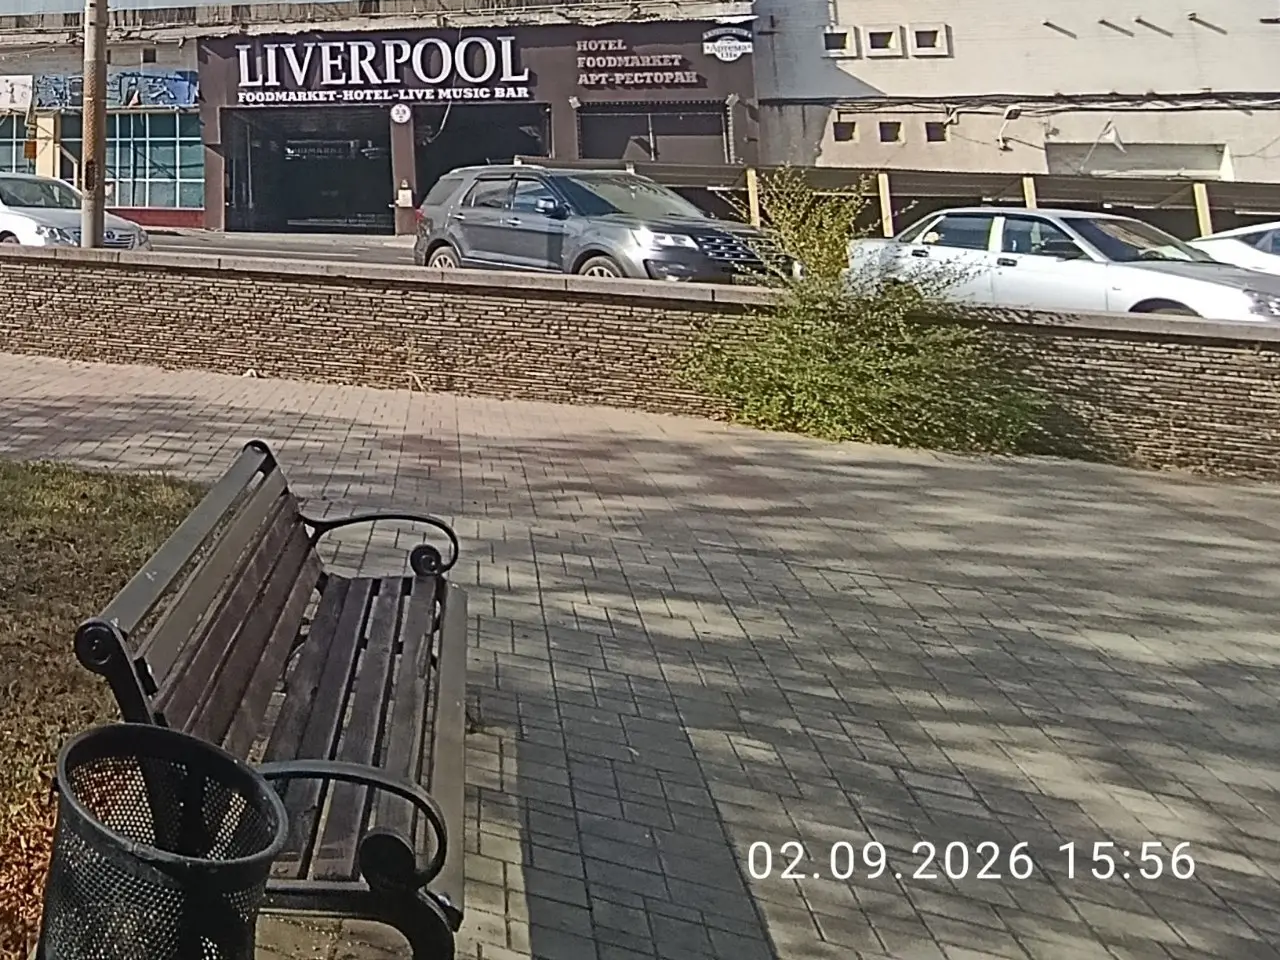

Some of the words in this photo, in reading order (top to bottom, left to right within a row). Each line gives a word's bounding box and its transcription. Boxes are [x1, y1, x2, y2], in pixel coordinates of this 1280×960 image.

[576, 39, 627, 52] HOTEL
[236, 36, 529, 87] LIVERPOOL
[577, 54, 682, 68] FOODMARKET
[578, 71, 698, 85] АРТ-РЕСТОРАН
[238, 88, 435, 103] FOODMARKET-HOTEL-LIVE
[438, 87, 491, 99] MUSIC
[495, 86, 529, 99] BAR
